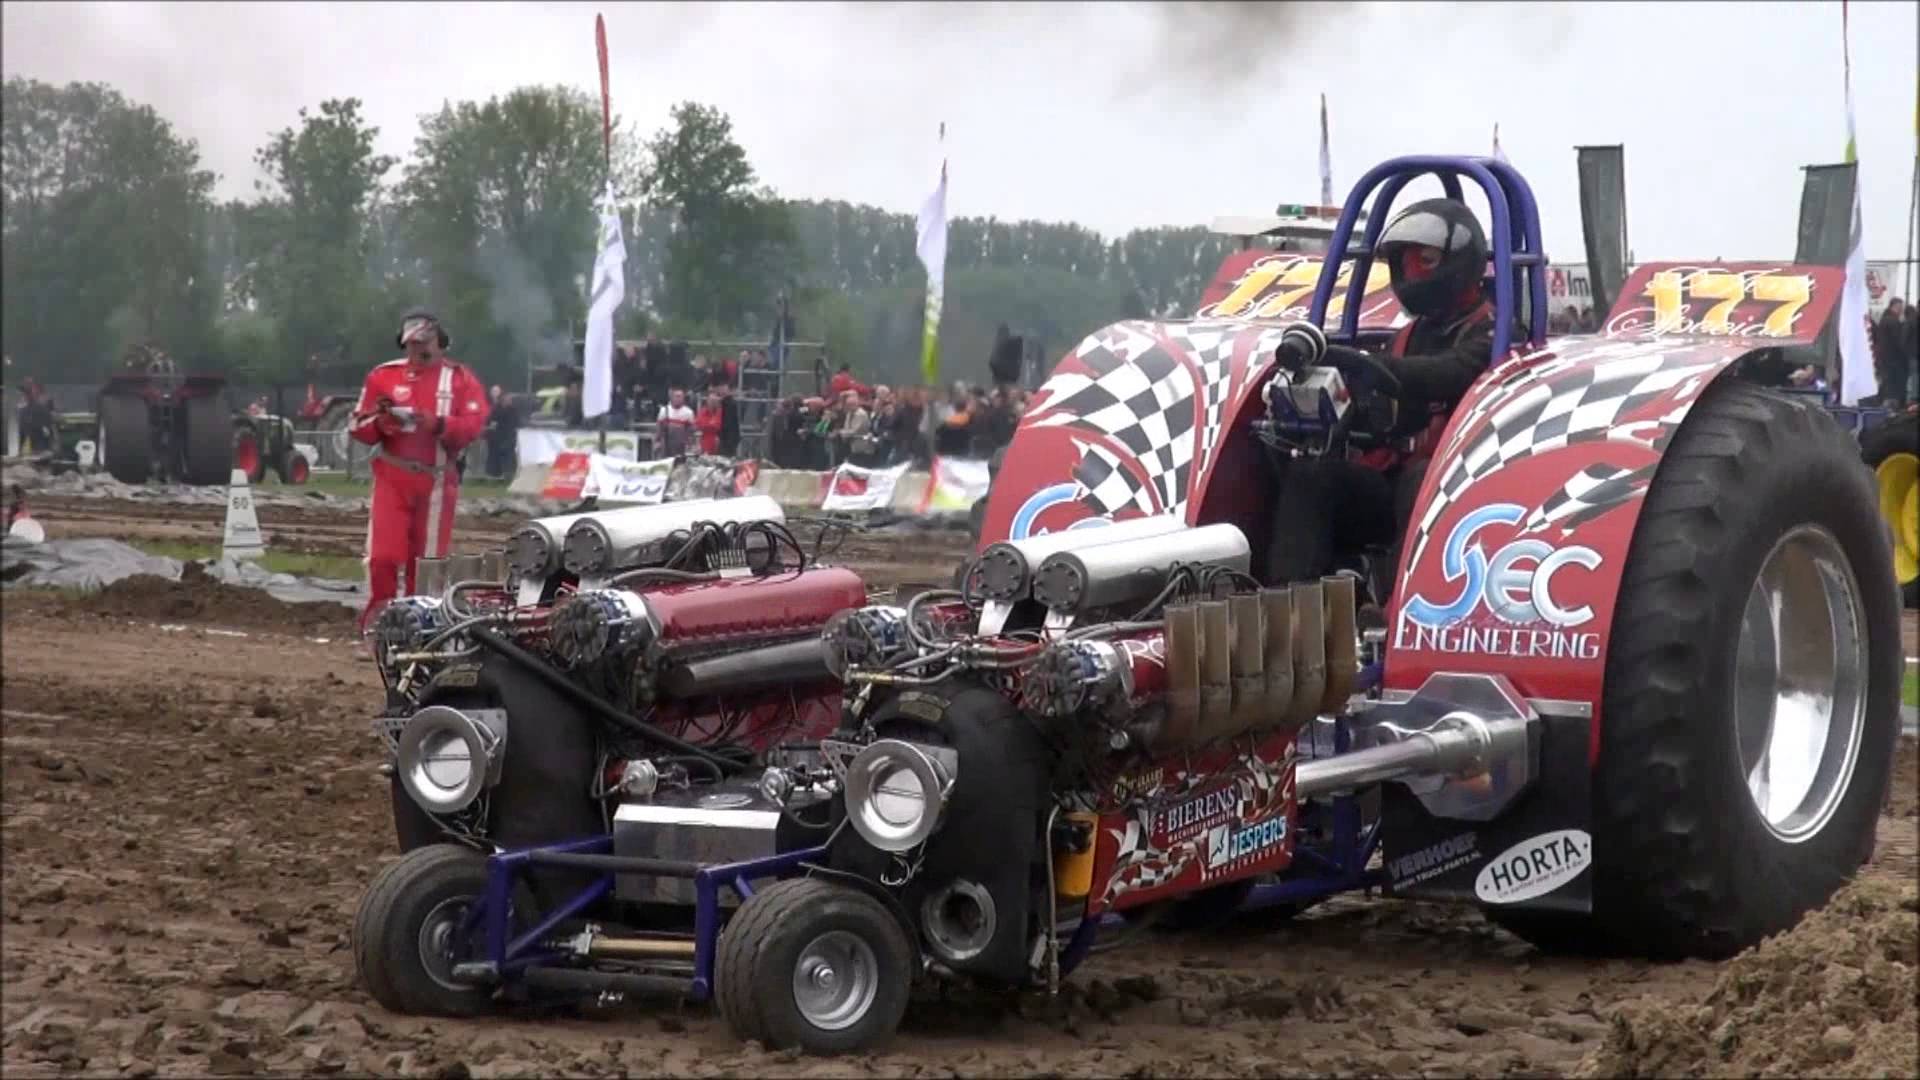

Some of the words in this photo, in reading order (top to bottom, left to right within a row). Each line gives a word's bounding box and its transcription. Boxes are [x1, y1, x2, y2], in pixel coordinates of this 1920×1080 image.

[1641, 271, 1811, 337] 177
[1394, 609, 1600, 659] ENGINEERING
[1167, 785, 1236, 833] BIERENS
[1230, 815, 1288, 860] JESPERS
[1490, 836, 1582, 891] HORTA
